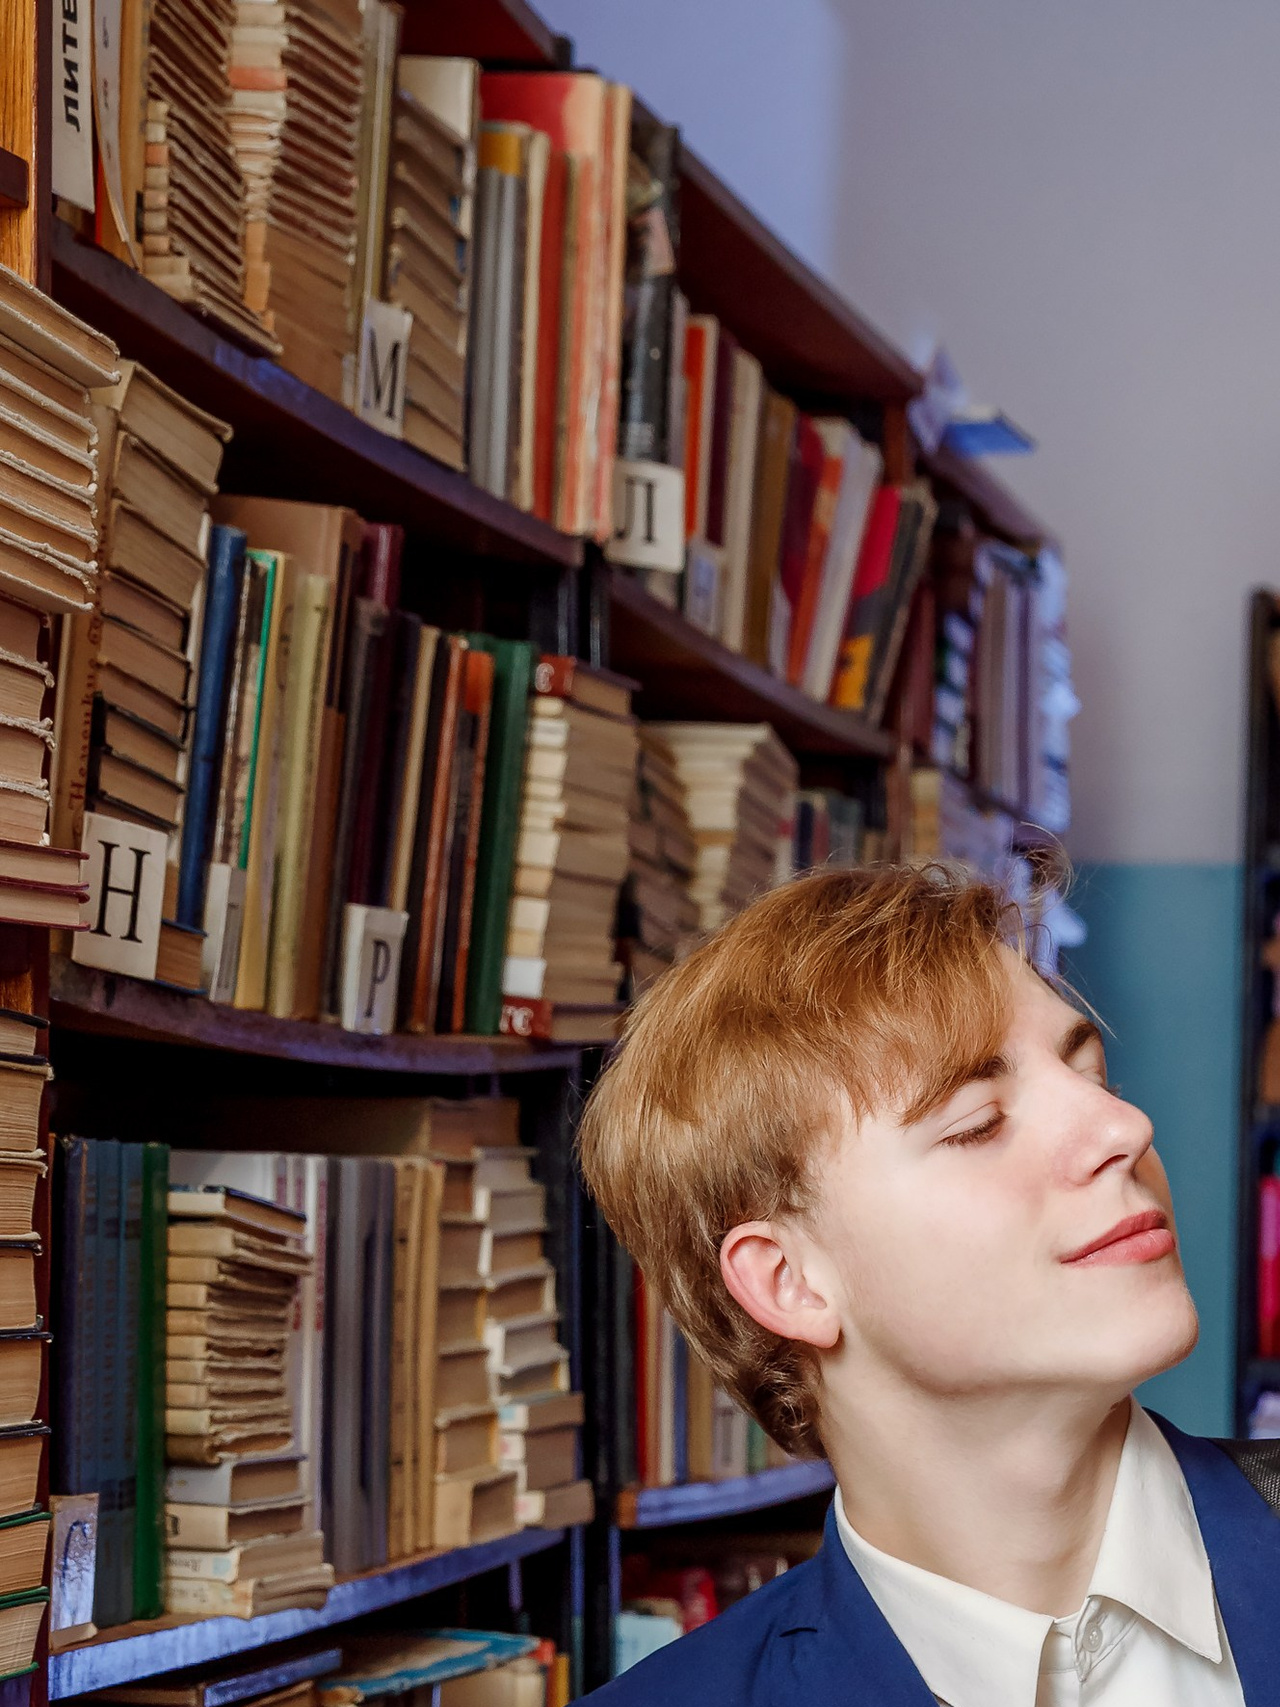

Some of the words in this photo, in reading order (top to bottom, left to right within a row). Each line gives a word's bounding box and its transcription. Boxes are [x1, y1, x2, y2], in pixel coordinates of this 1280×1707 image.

[363, 325, 402, 421] М
[612, 476, 657, 546] Л
[89, 839, 151, 944] Н
[364, 938, 391, 1019] Р
